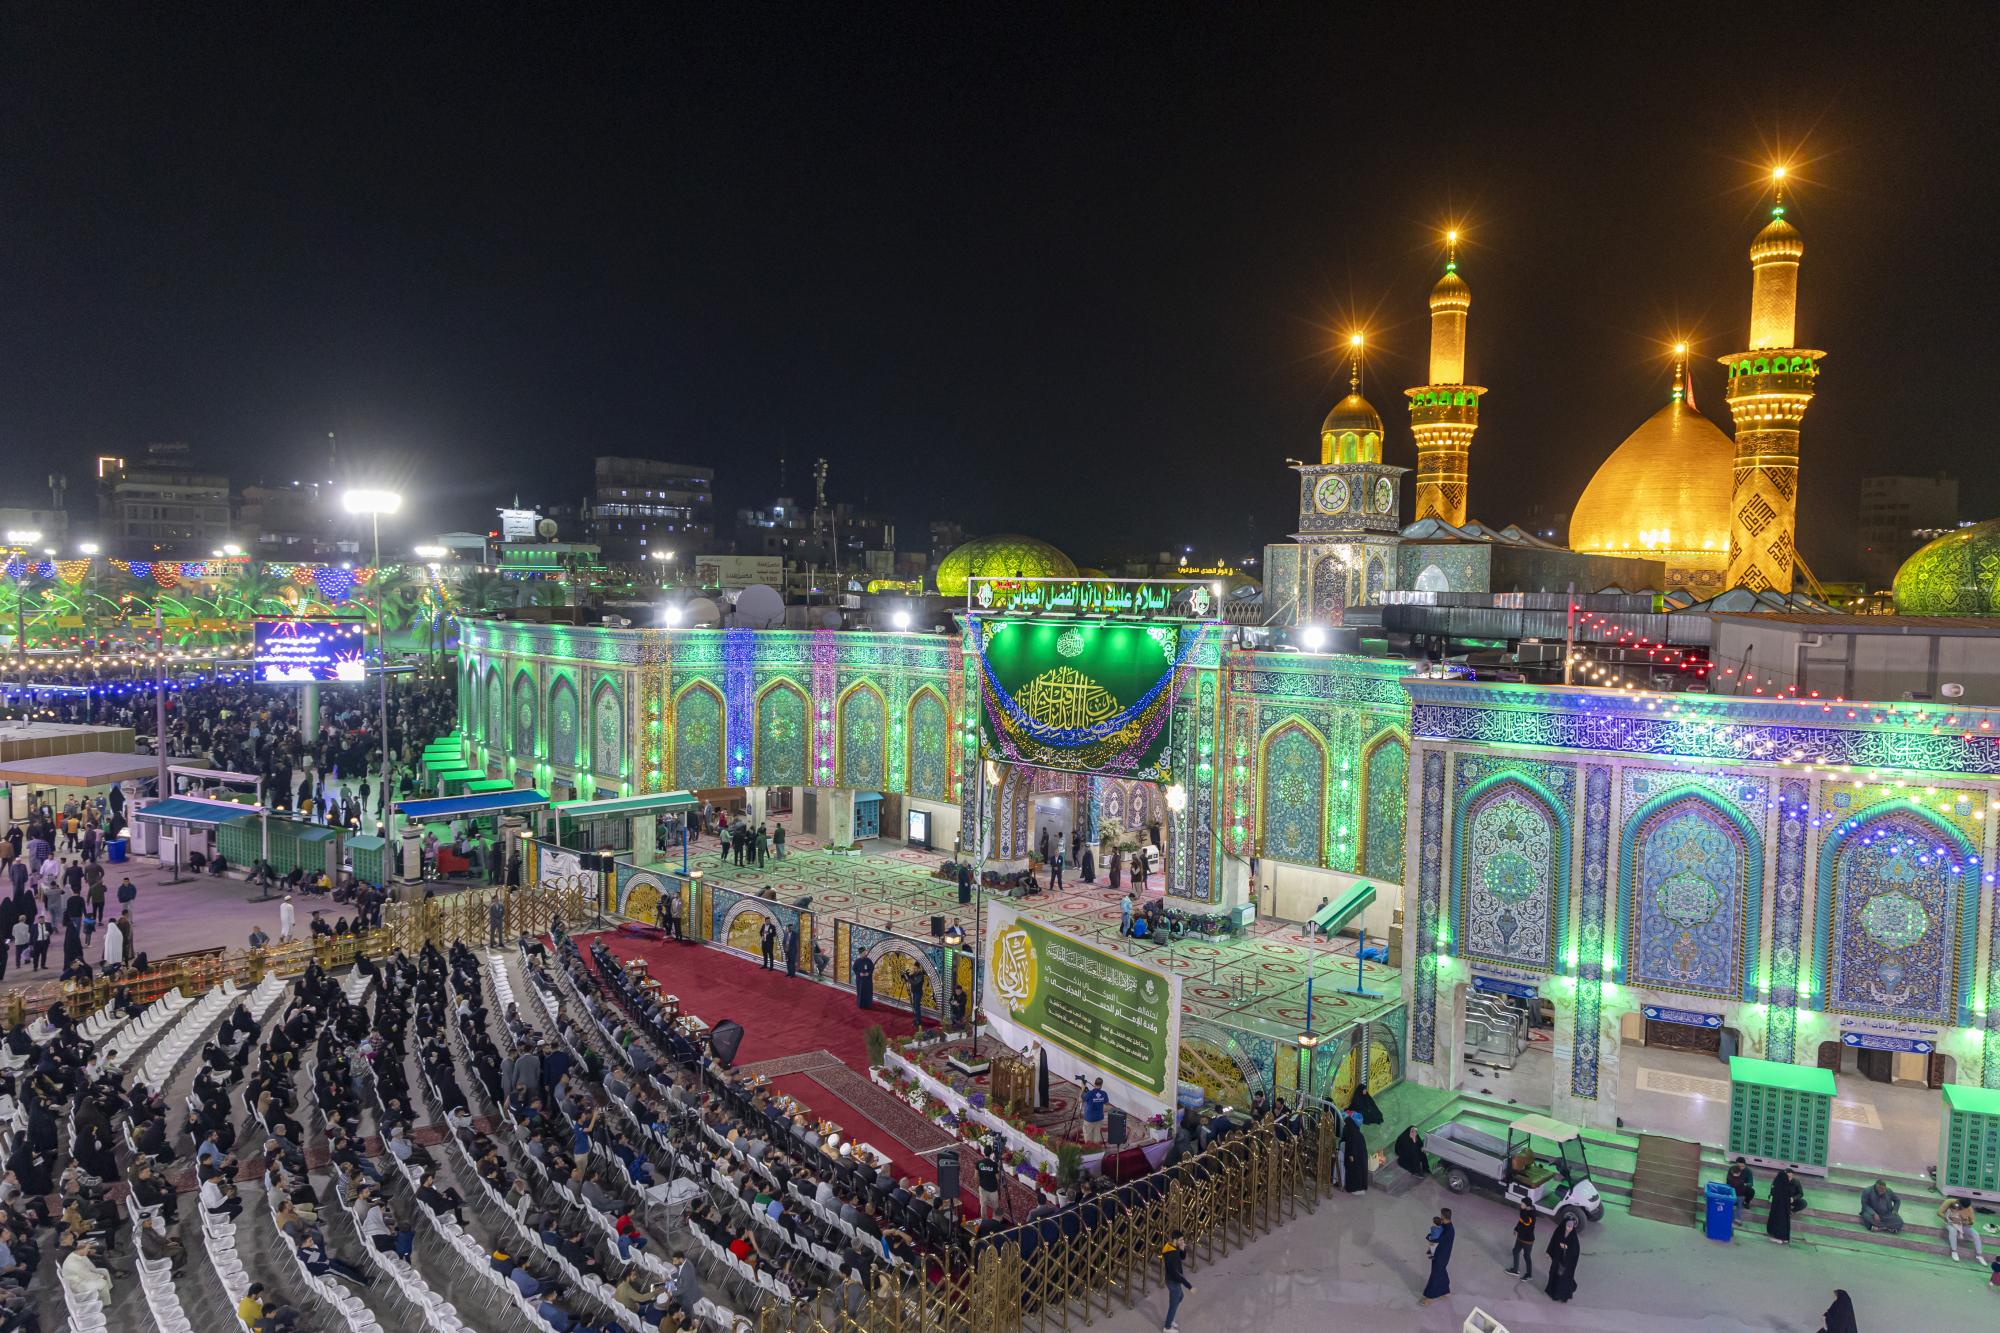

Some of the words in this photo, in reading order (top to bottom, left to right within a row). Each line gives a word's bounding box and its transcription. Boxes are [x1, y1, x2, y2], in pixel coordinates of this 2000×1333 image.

[1007, 583, 1044, 611] العباس
[1045, 583, 1080, 611] الفضل
[1105, 584, 1133, 613] عليك
[1135, 583, 1171, 613] السلام
